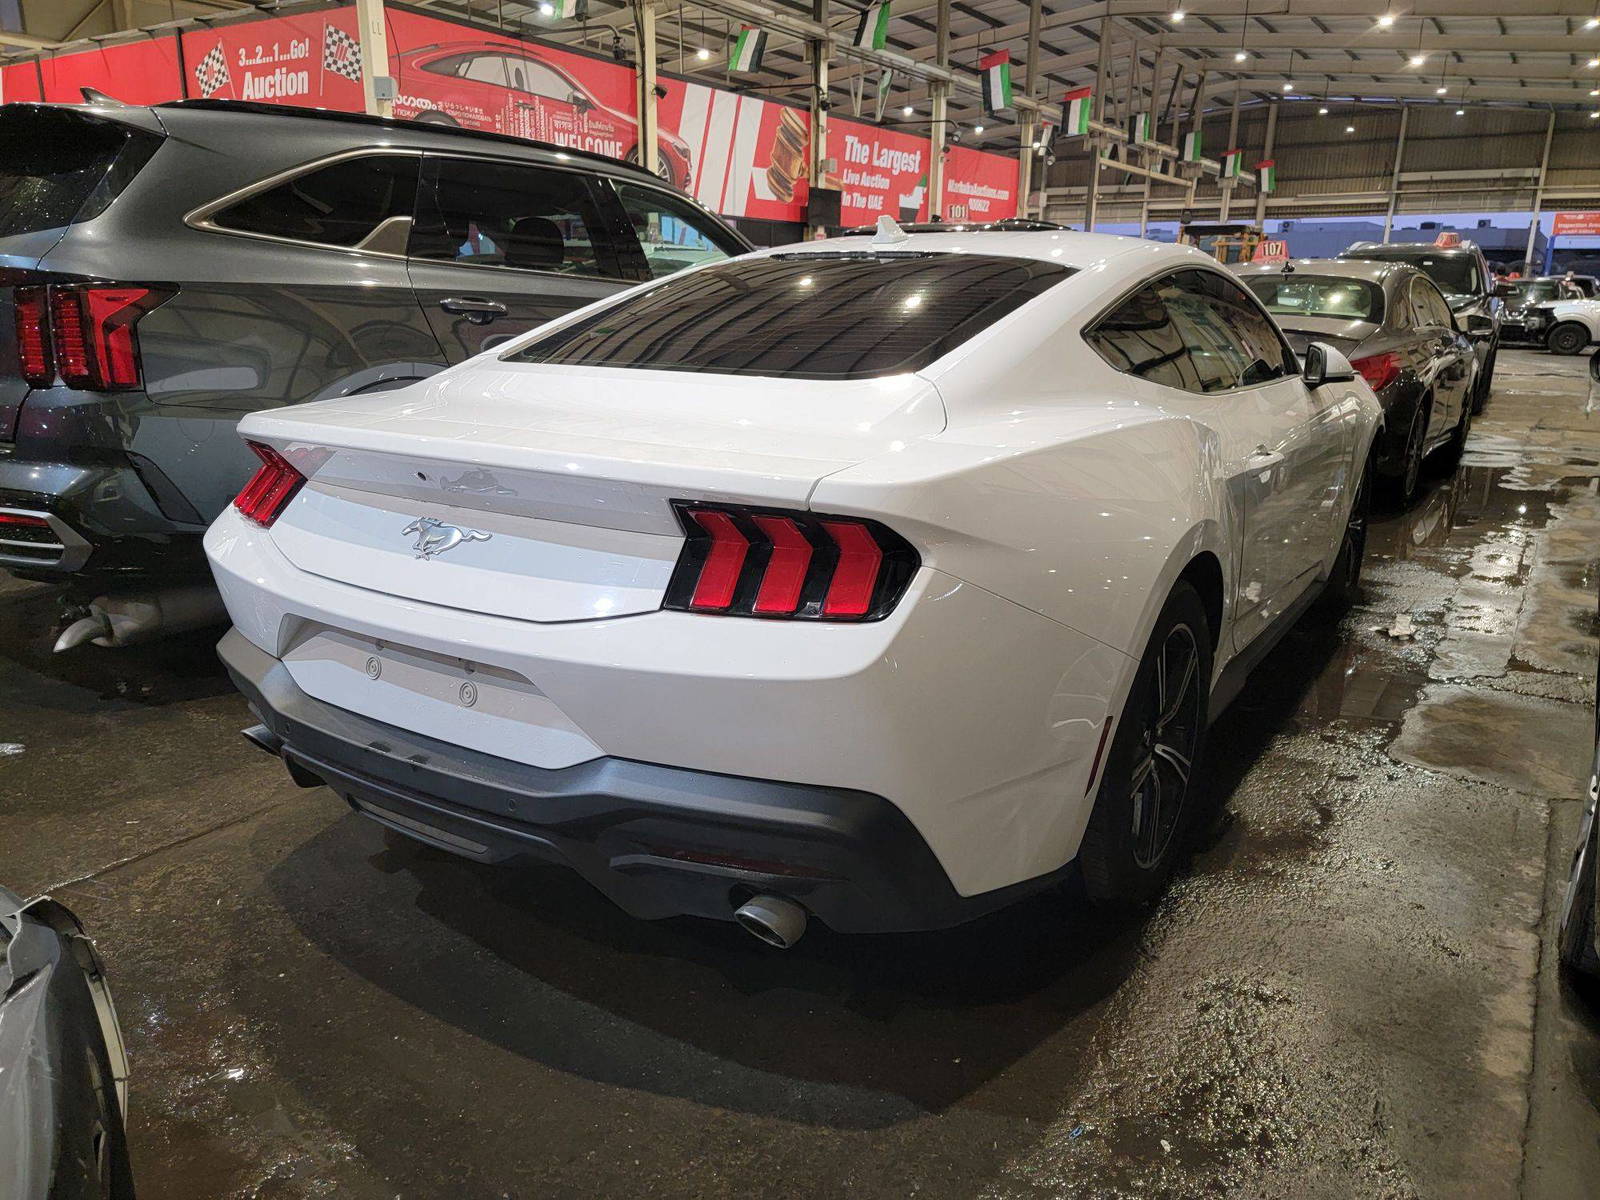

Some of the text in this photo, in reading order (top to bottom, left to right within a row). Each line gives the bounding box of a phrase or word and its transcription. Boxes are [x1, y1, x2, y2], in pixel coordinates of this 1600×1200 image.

[242, 67, 308, 100] Auction
[554, 132, 623, 160] WELCOME
[845, 135, 921, 175] The Largest
[843, 168, 890, 190] Live Auction
[841, 191, 884, 210] In The UAE
[951, 205, 966, 218] 101
[1263, 242, 1282, 256] 107
